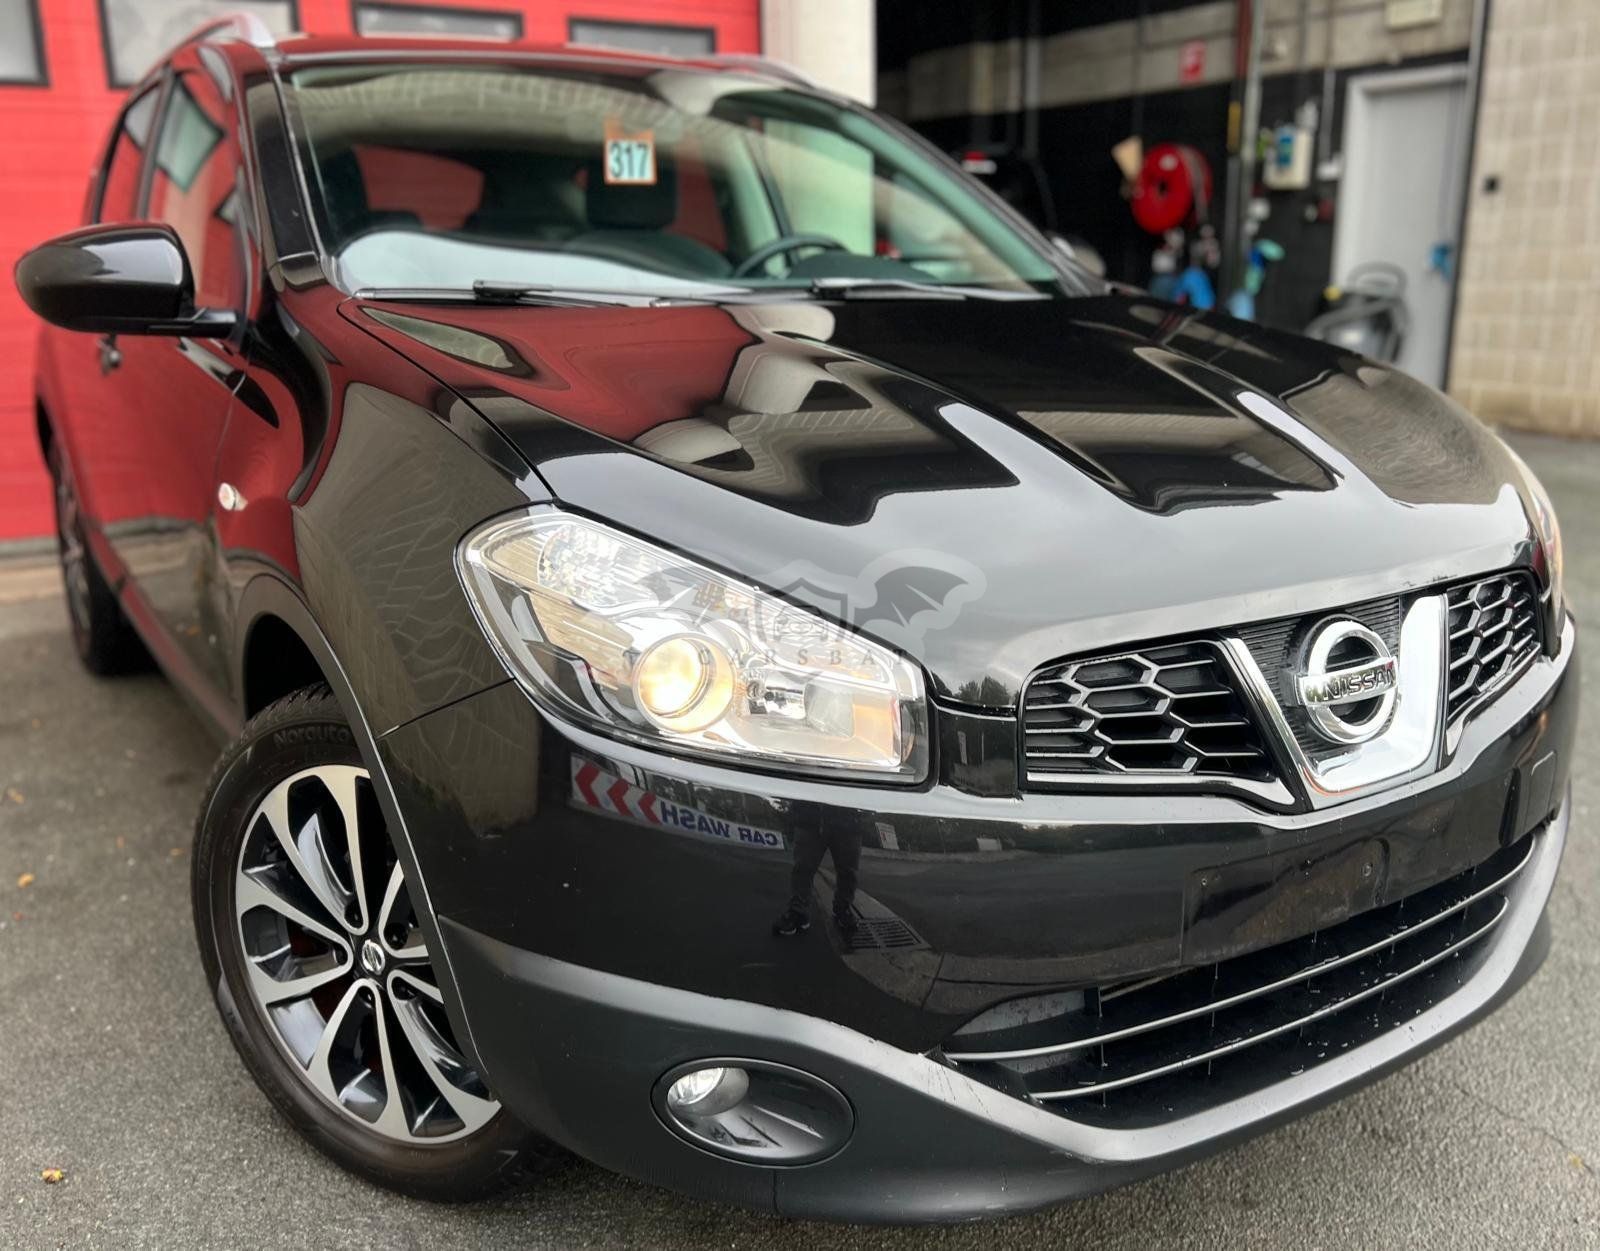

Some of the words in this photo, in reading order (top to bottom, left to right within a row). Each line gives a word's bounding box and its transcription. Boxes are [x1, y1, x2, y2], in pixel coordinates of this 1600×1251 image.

[610, 142, 649, 178] 317
[1322, 668, 1395, 701] NISSAN
[272, 725, 350, 747] Norauto
